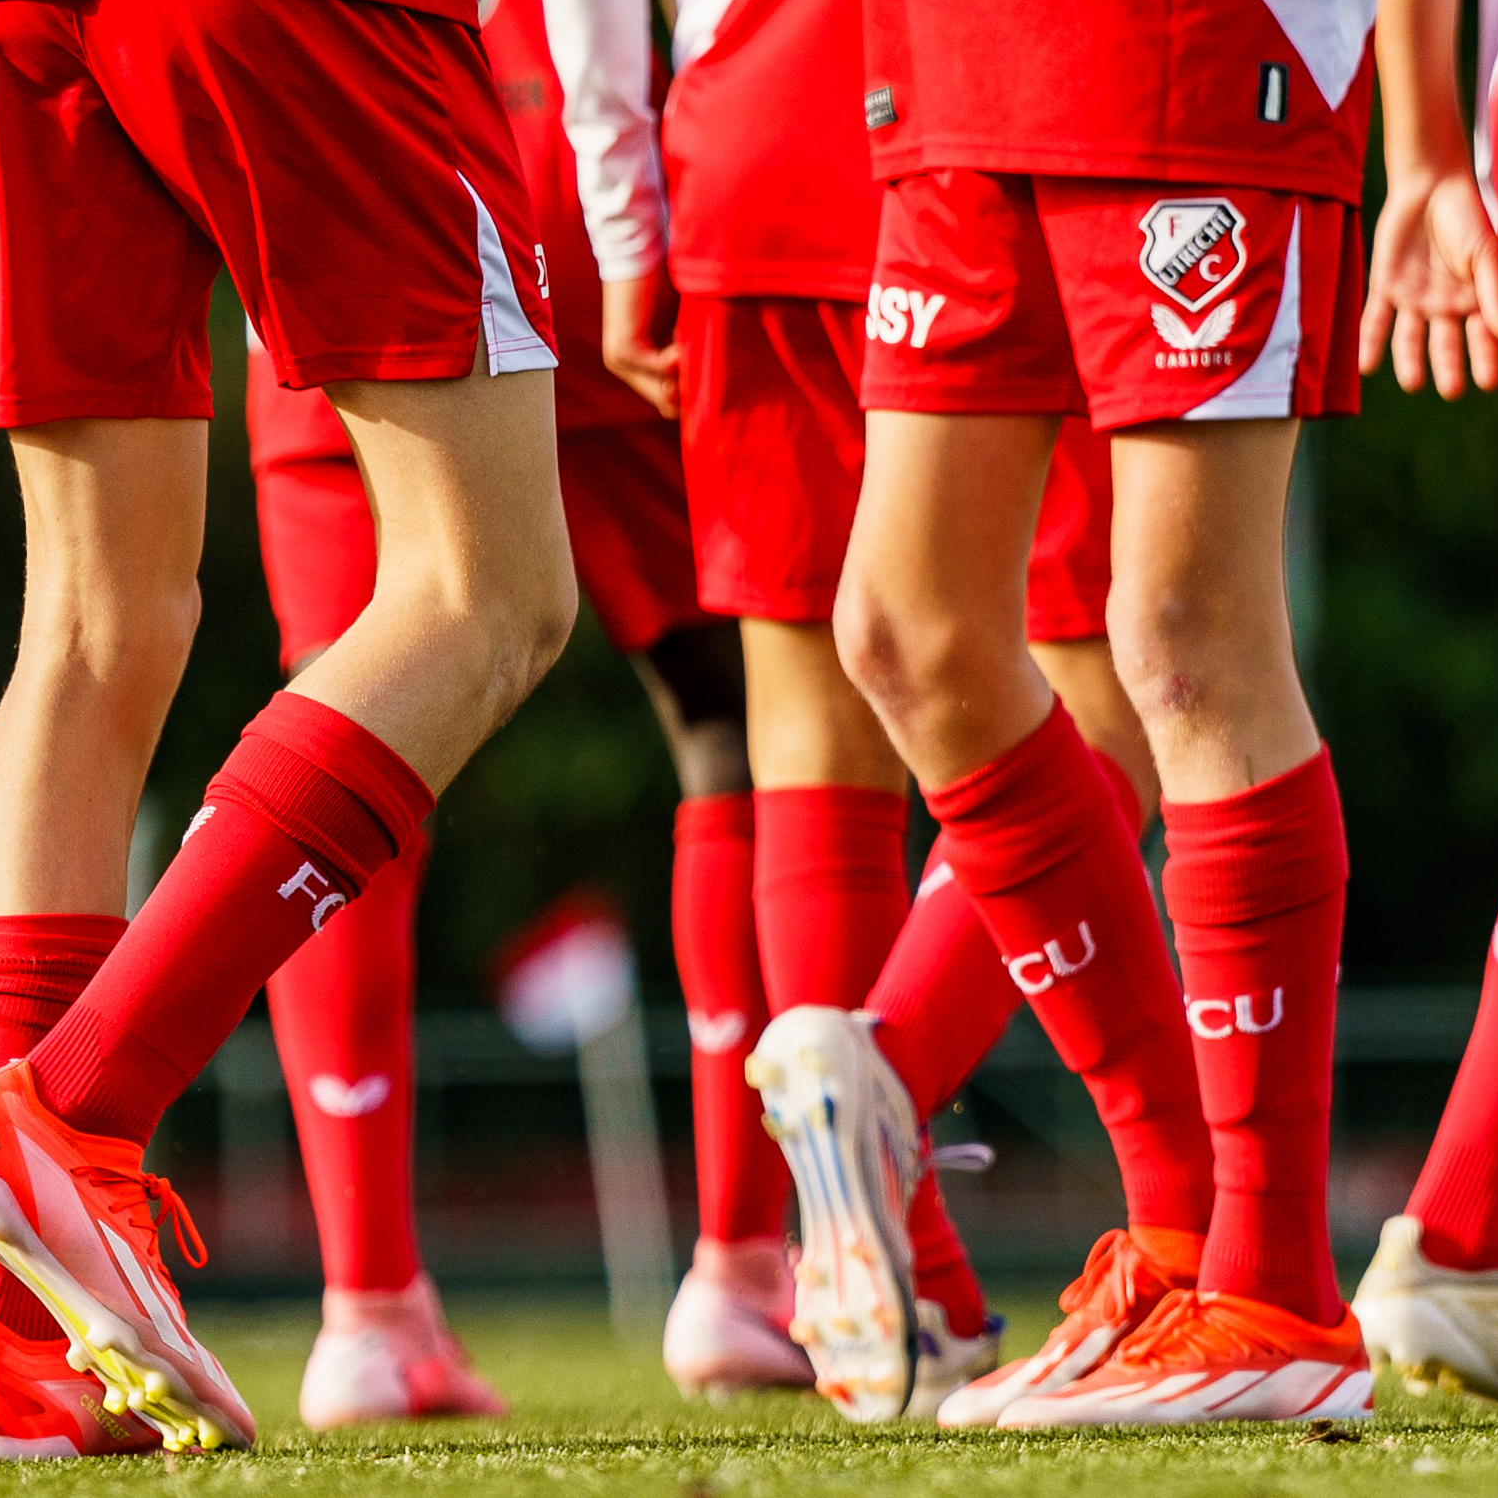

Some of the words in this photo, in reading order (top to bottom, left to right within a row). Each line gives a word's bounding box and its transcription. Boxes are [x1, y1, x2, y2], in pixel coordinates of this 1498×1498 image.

[1158, 208, 1234, 287] UTRECHT
[1199, 254, 1223, 283] C
[1155, 351, 1233, 370] CASTORE
